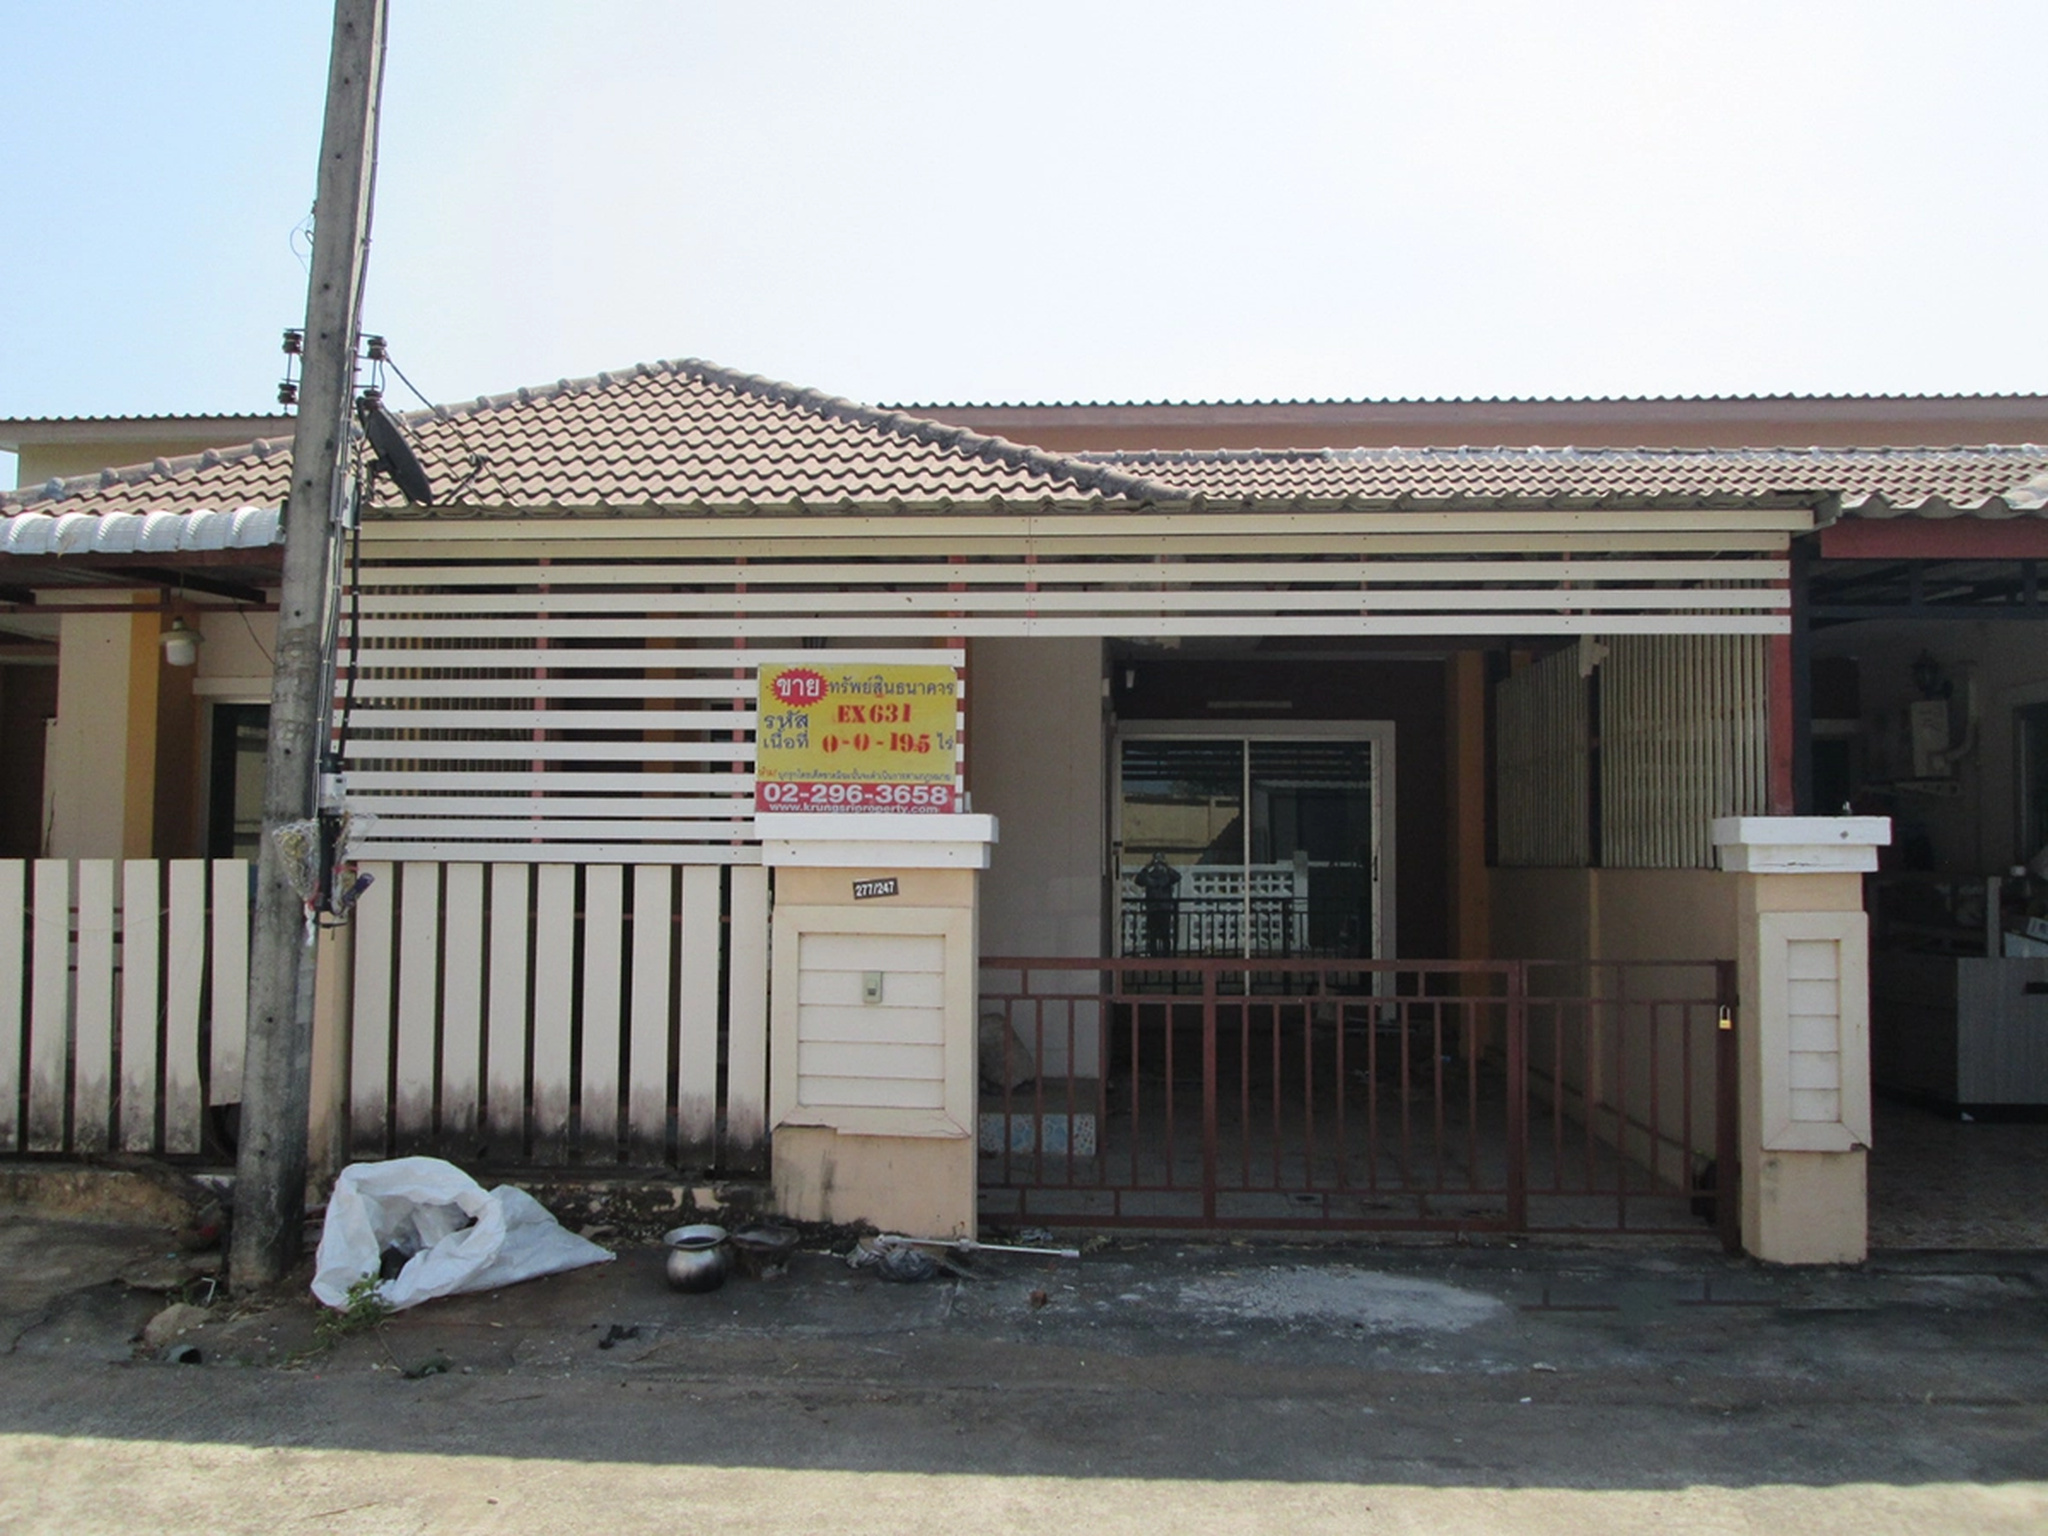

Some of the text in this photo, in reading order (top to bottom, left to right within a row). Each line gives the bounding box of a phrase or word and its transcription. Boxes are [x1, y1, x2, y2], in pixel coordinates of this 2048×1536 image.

[776, 678, 820, 697] ขาย
[764, 710, 809, 729] รหัส
[763, 783, 948, 805] 02-296-3658
[769, 803, 939, 813] www.krungsriproperty.com
